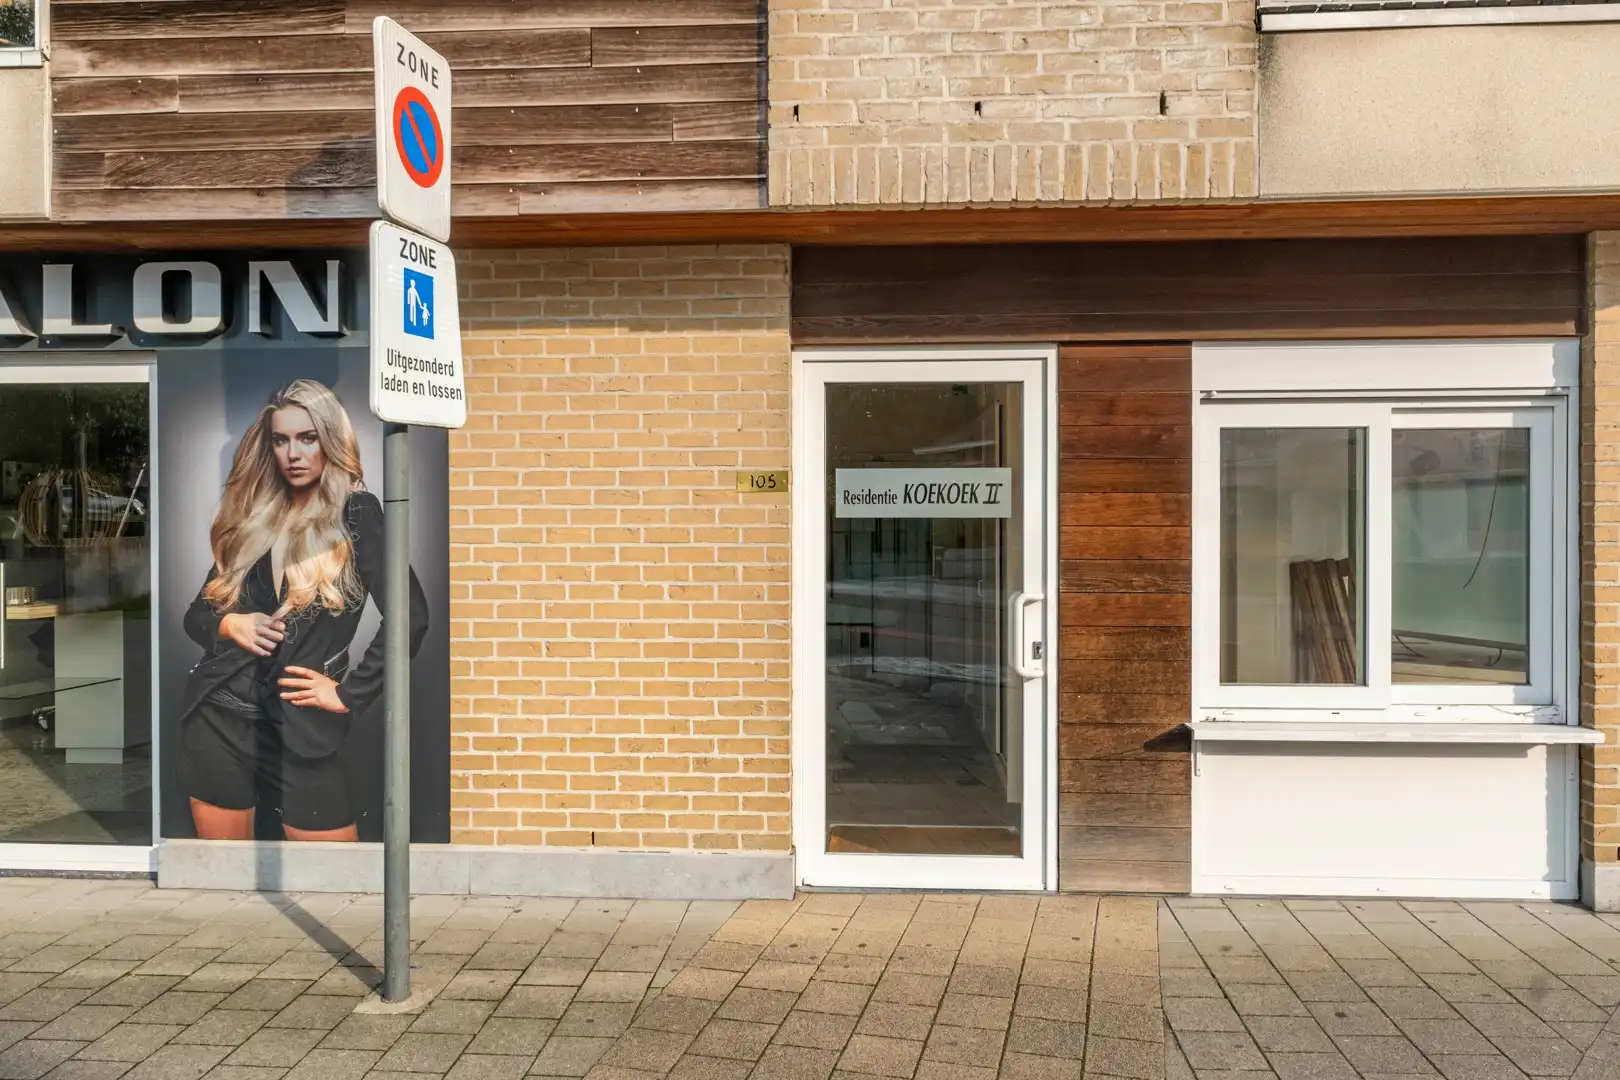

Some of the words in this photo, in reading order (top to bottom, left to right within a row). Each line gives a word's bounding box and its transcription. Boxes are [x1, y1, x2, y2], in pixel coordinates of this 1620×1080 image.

[396, 42, 439, 89] ZONE
[400, 238, 437, 269] ZONE
[387, 348, 454, 377] Uitgezonderd
[381, 371, 409, 393] laden
[411, 381, 425, 396] en
[428, 377, 462, 401] lossen
[749, 473, 777, 489] 105
[843, 489, 898, 505] Residentie
[903, 483, 981, 505] KOEKOEK
